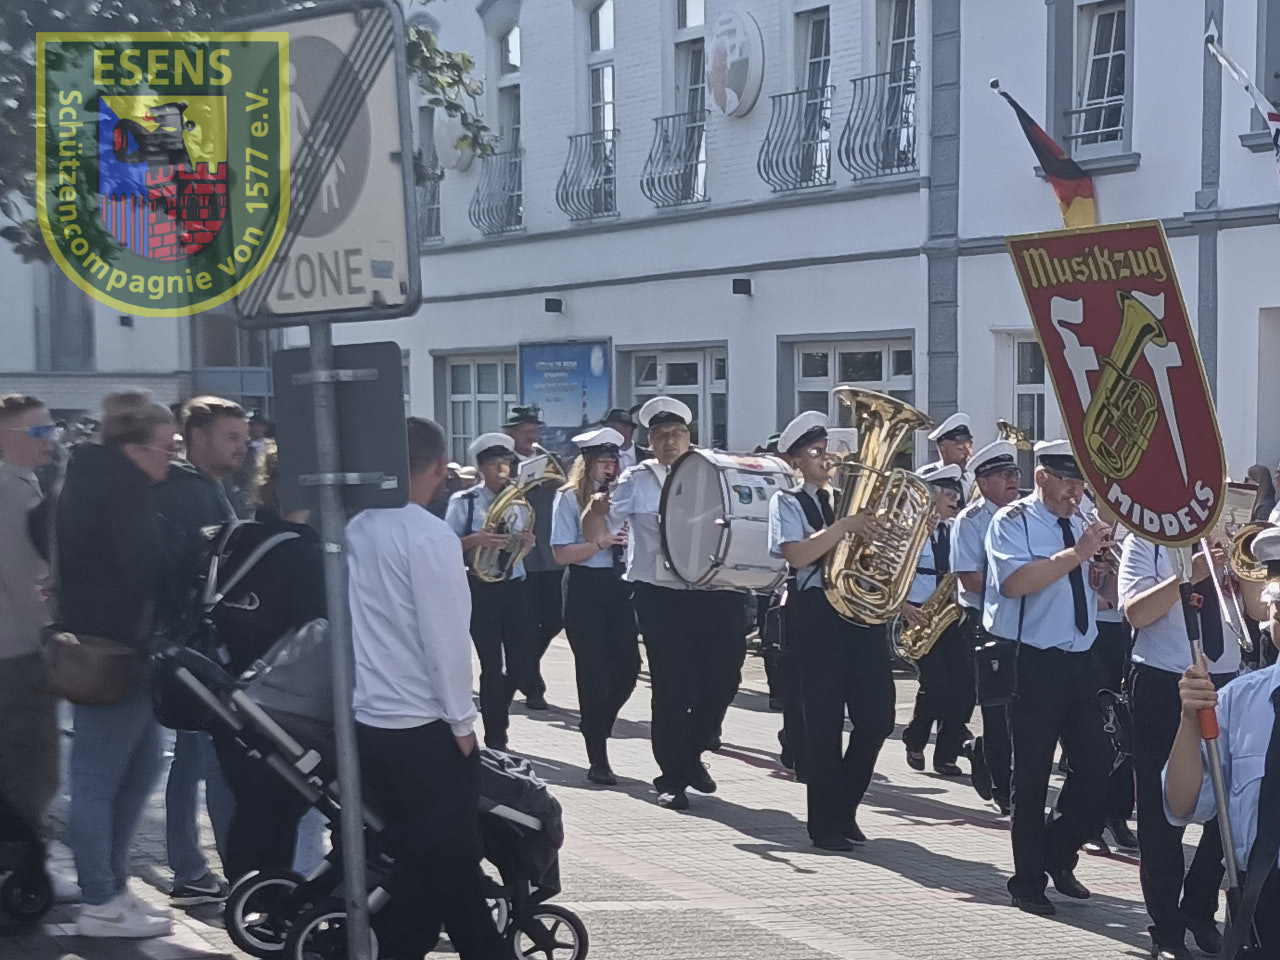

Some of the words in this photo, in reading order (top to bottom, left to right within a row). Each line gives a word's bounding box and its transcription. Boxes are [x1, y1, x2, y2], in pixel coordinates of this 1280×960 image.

[277, 248, 366, 301] ZONE
[1022, 245, 1167, 288] Musikzug
[1107, 480, 1214, 537] MIDDELS
